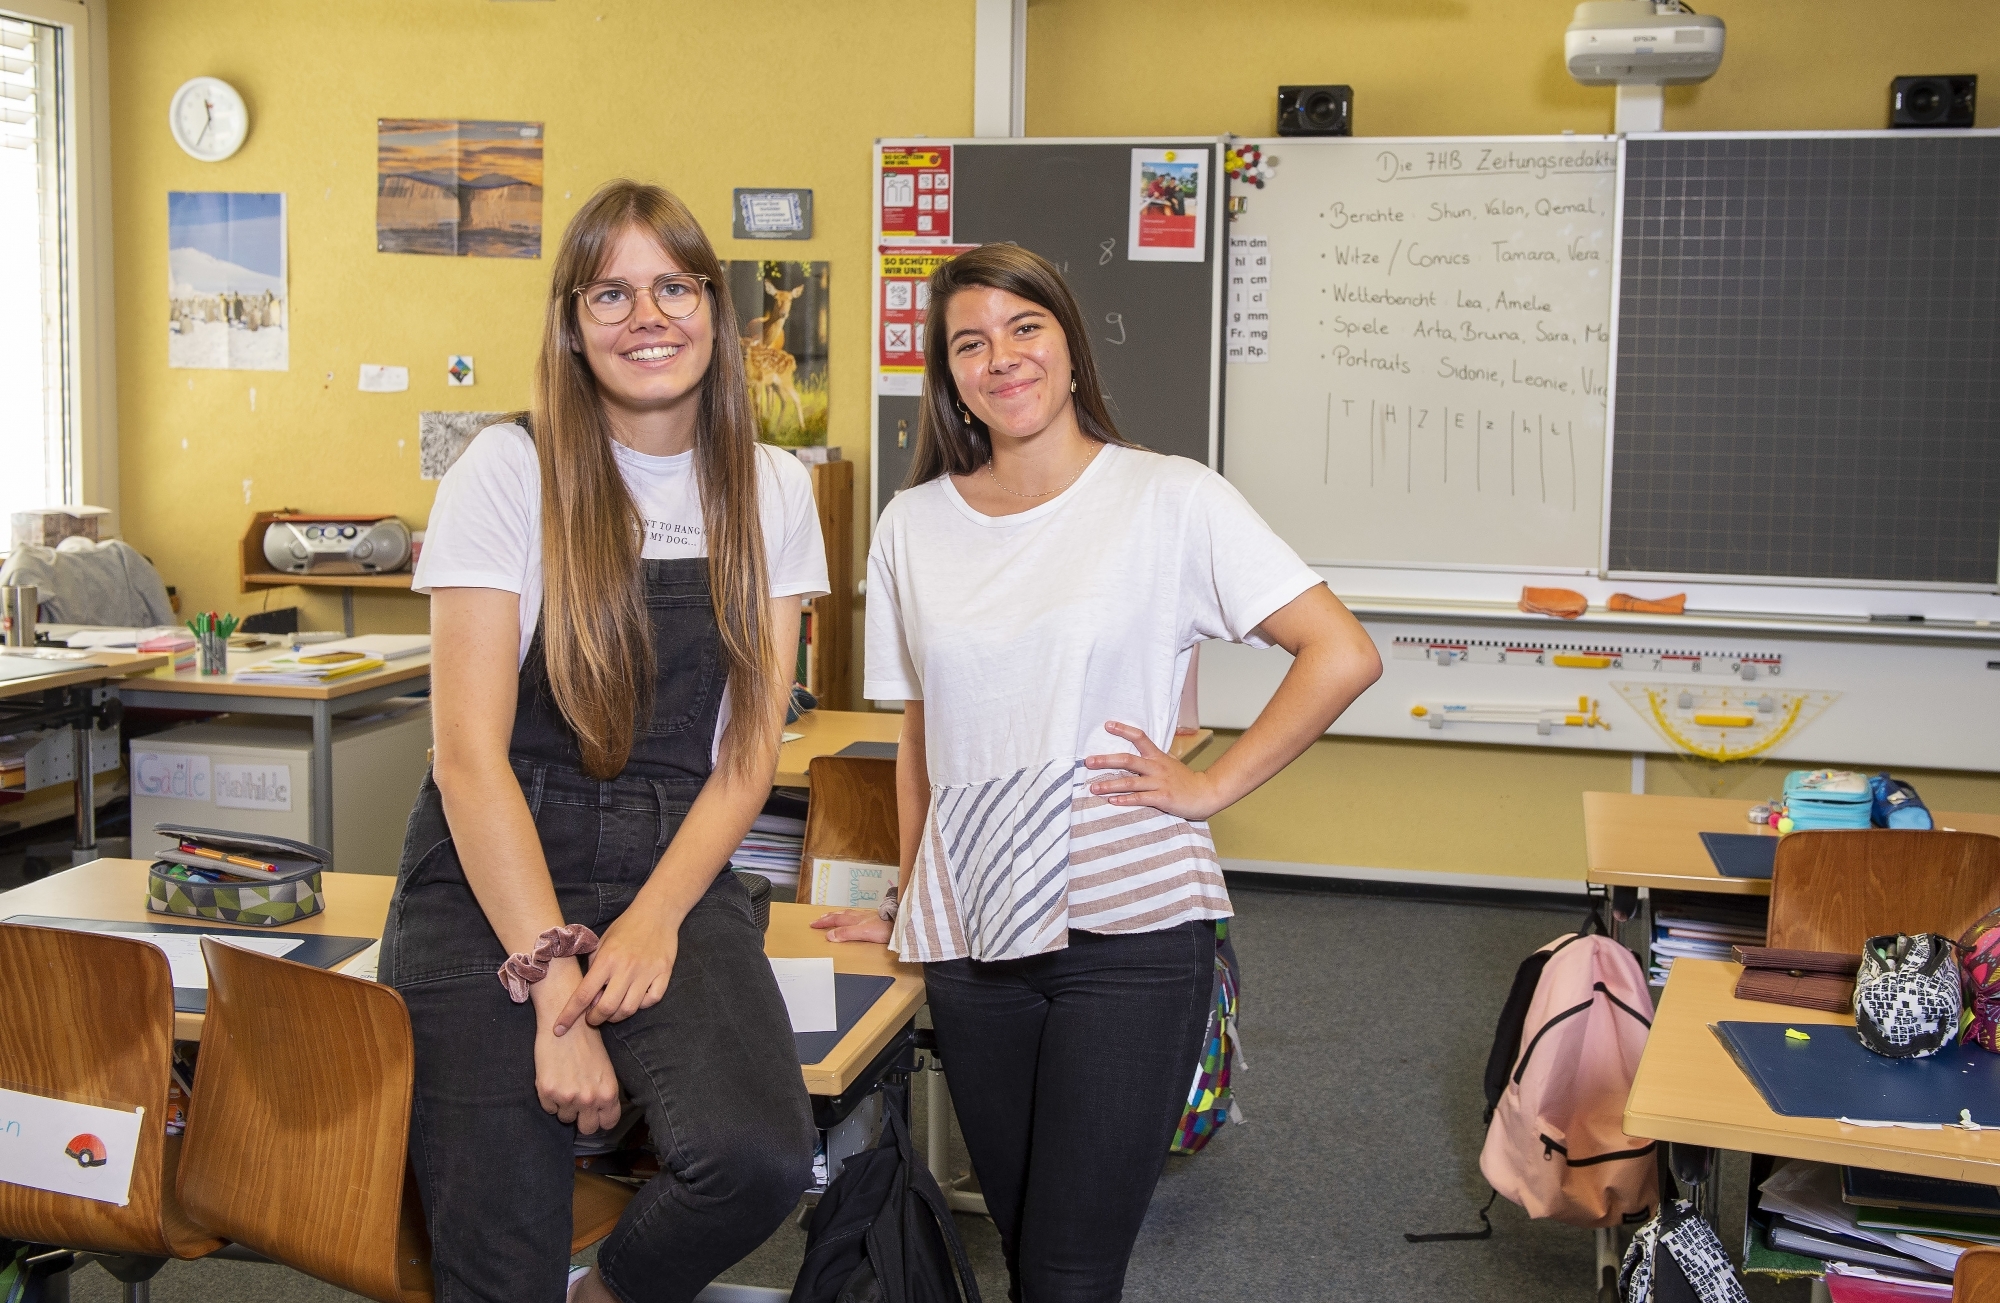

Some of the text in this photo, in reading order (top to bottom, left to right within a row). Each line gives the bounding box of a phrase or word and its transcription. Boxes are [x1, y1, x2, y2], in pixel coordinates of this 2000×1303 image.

[1376, 151, 1412, 182] Die
[1426, 149, 1463, 171] 7HB
[1329, 201, 1404, 229] Berichte
[1485, 198, 1530, 219] Valon,
[1099, 237, 1116, 265] 8
[1230, 238, 1267, 248] km dm
[1335, 245, 1380, 265] Witze
[1407, 242, 1470, 267] Comics
[1491, 240, 1560, 263] Tamara,
[884, 258, 896, 266] SO
[1235, 256, 1267, 266] hl dl
[1233, 275, 1267, 284] m cm
[1495, 290, 1552, 312] Amelie
[1234, 312, 1268, 322] g mm
[1230, 328, 1268, 340] Fr. mg
[1334, 315, 1389, 338] Spiele
[1413, 319, 1457, 342] Arta,
[1460, 320, 1525, 344] Bruna,
[1535, 320, 1577, 345] Sara,
[1229, 345, 1266, 357] ml Rp.
[1332, 344, 1411, 374] Portraits
[1437, 356, 1504, 388] Sidonie,
[1511, 358, 1576, 395] Leonie,
[1342, 399, 1355, 417] T
[1385, 404, 1396, 424] H
[1455, 413, 1464, 428] E
[650, 532, 663, 542] MY
[666, 535, 697, 546] DOG...
[660, 522, 672, 531] TO
[674, 524, 701, 535] HANG
[1425, 649, 1430, 659] 1
[1460, 652, 1467, 661] 2
[1498, 653, 1505, 663] 3
[1535, 655, 1544, 665] 4
[1613, 658, 1620, 668] 6
[1652, 659, 1660, 669] 7
[1692, 662, 1700, 672] 8
[1731, 663, 1740, 673] 9
[1768, 665, 1781, 675] 10
[136, 753, 206, 798] Gaëlle
